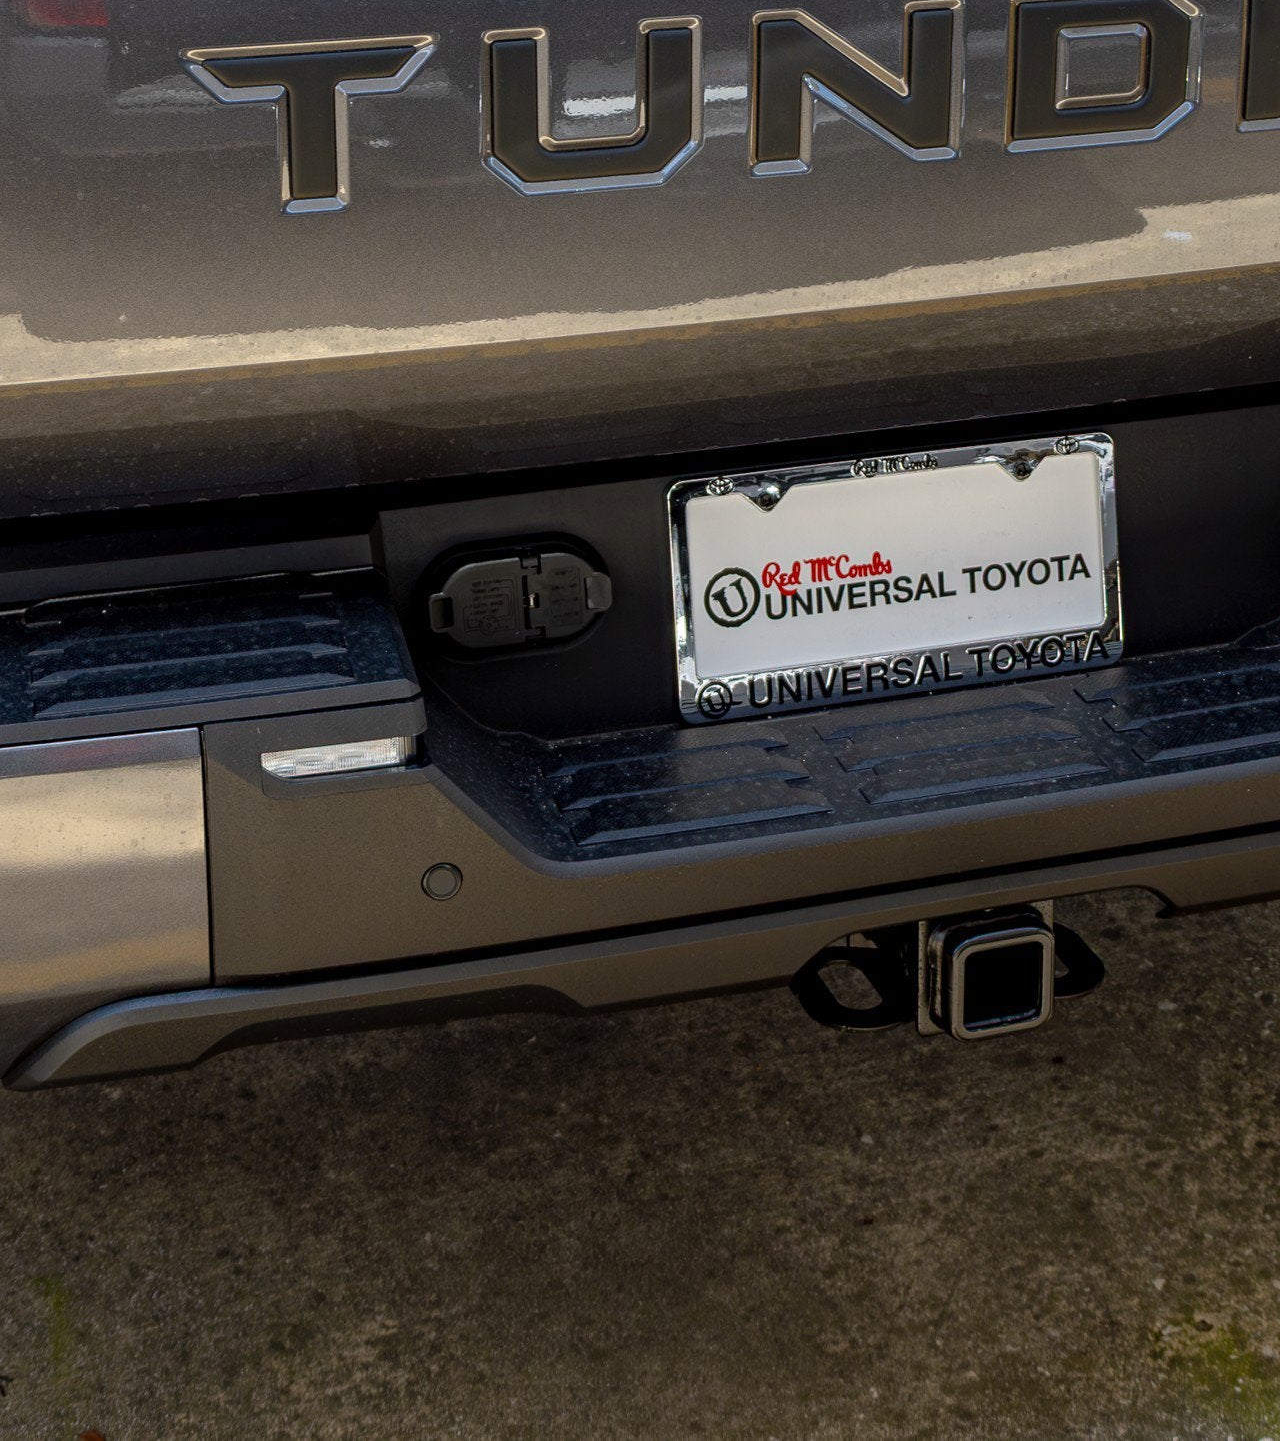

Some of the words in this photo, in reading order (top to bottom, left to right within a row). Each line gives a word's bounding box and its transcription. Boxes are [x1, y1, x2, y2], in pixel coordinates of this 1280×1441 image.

[849, 458, 879, 478] Red
[762, 560, 802, 596] Red
[804, 551, 892, 583] McCombs
[765, 571, 957, 621] UNIVERSAL
[962, 552, 1092, 594] TOYOTA
[747, 651, 964, 708] UNIVERSAL
[965, 630, 1110, 677] TOYOTA
